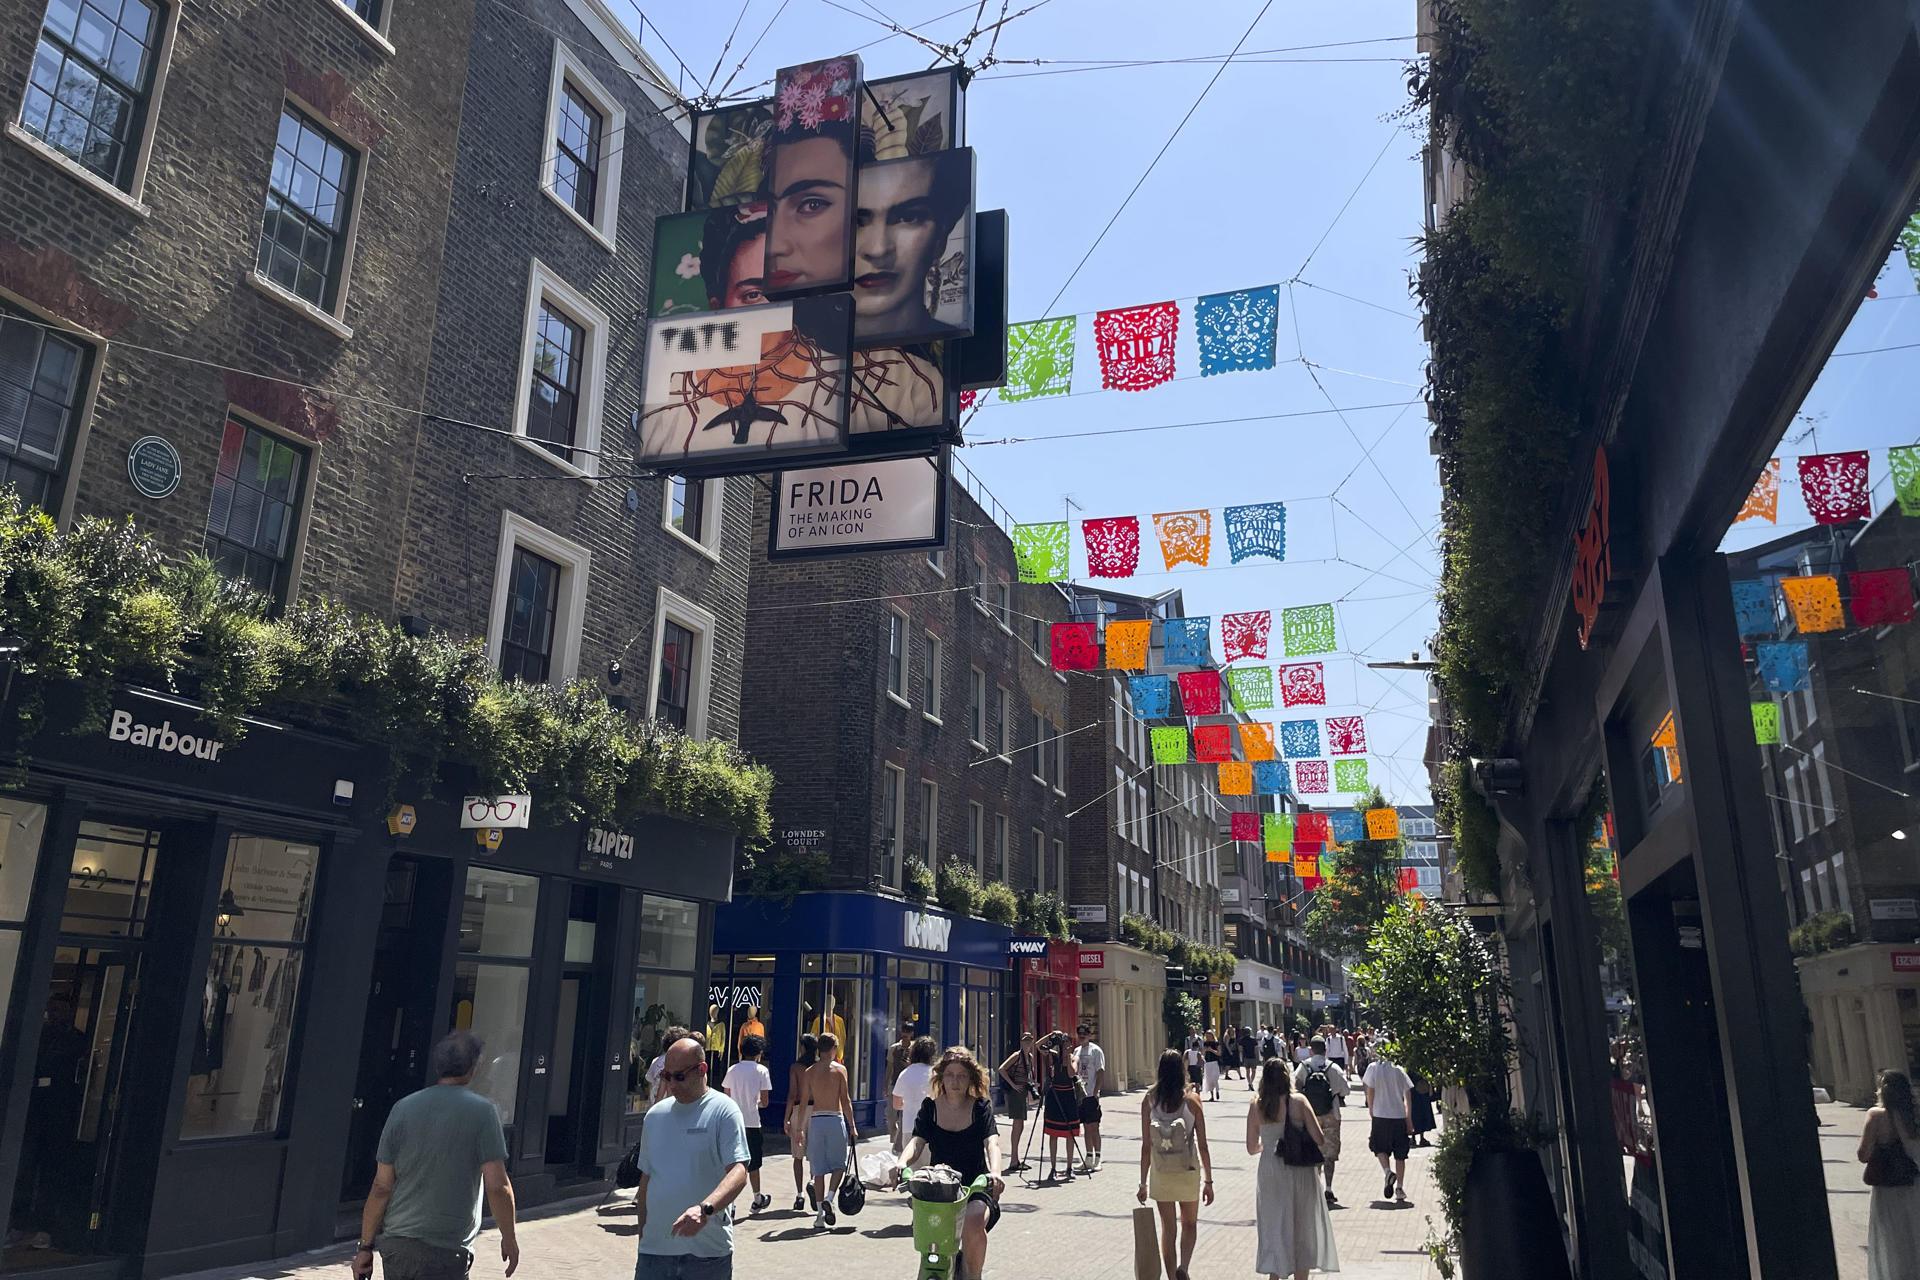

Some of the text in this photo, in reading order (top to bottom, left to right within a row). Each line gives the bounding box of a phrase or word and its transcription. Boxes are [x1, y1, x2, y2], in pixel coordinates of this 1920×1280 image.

[660, 321, 740, 353] TATE
[1104, 332, 1173, 361] FRIDA
[790, 476, 883, 509] FRIDA
[789, 508, 872, 525] THE MAKING
[788, 522, 864, 539] OF AN ICON
[1252, 528, 1280, 541] OWN
[1286, 620, 1331, 639] FRIDA
[109, 709, 224, 761] Barbour
[782, 830, 825, 839] LOWNDES
[787, 838, 819, 846] COURT
[79, 867, 108, 890] 29
[1080, 954, 1102, 964] DIESEL
